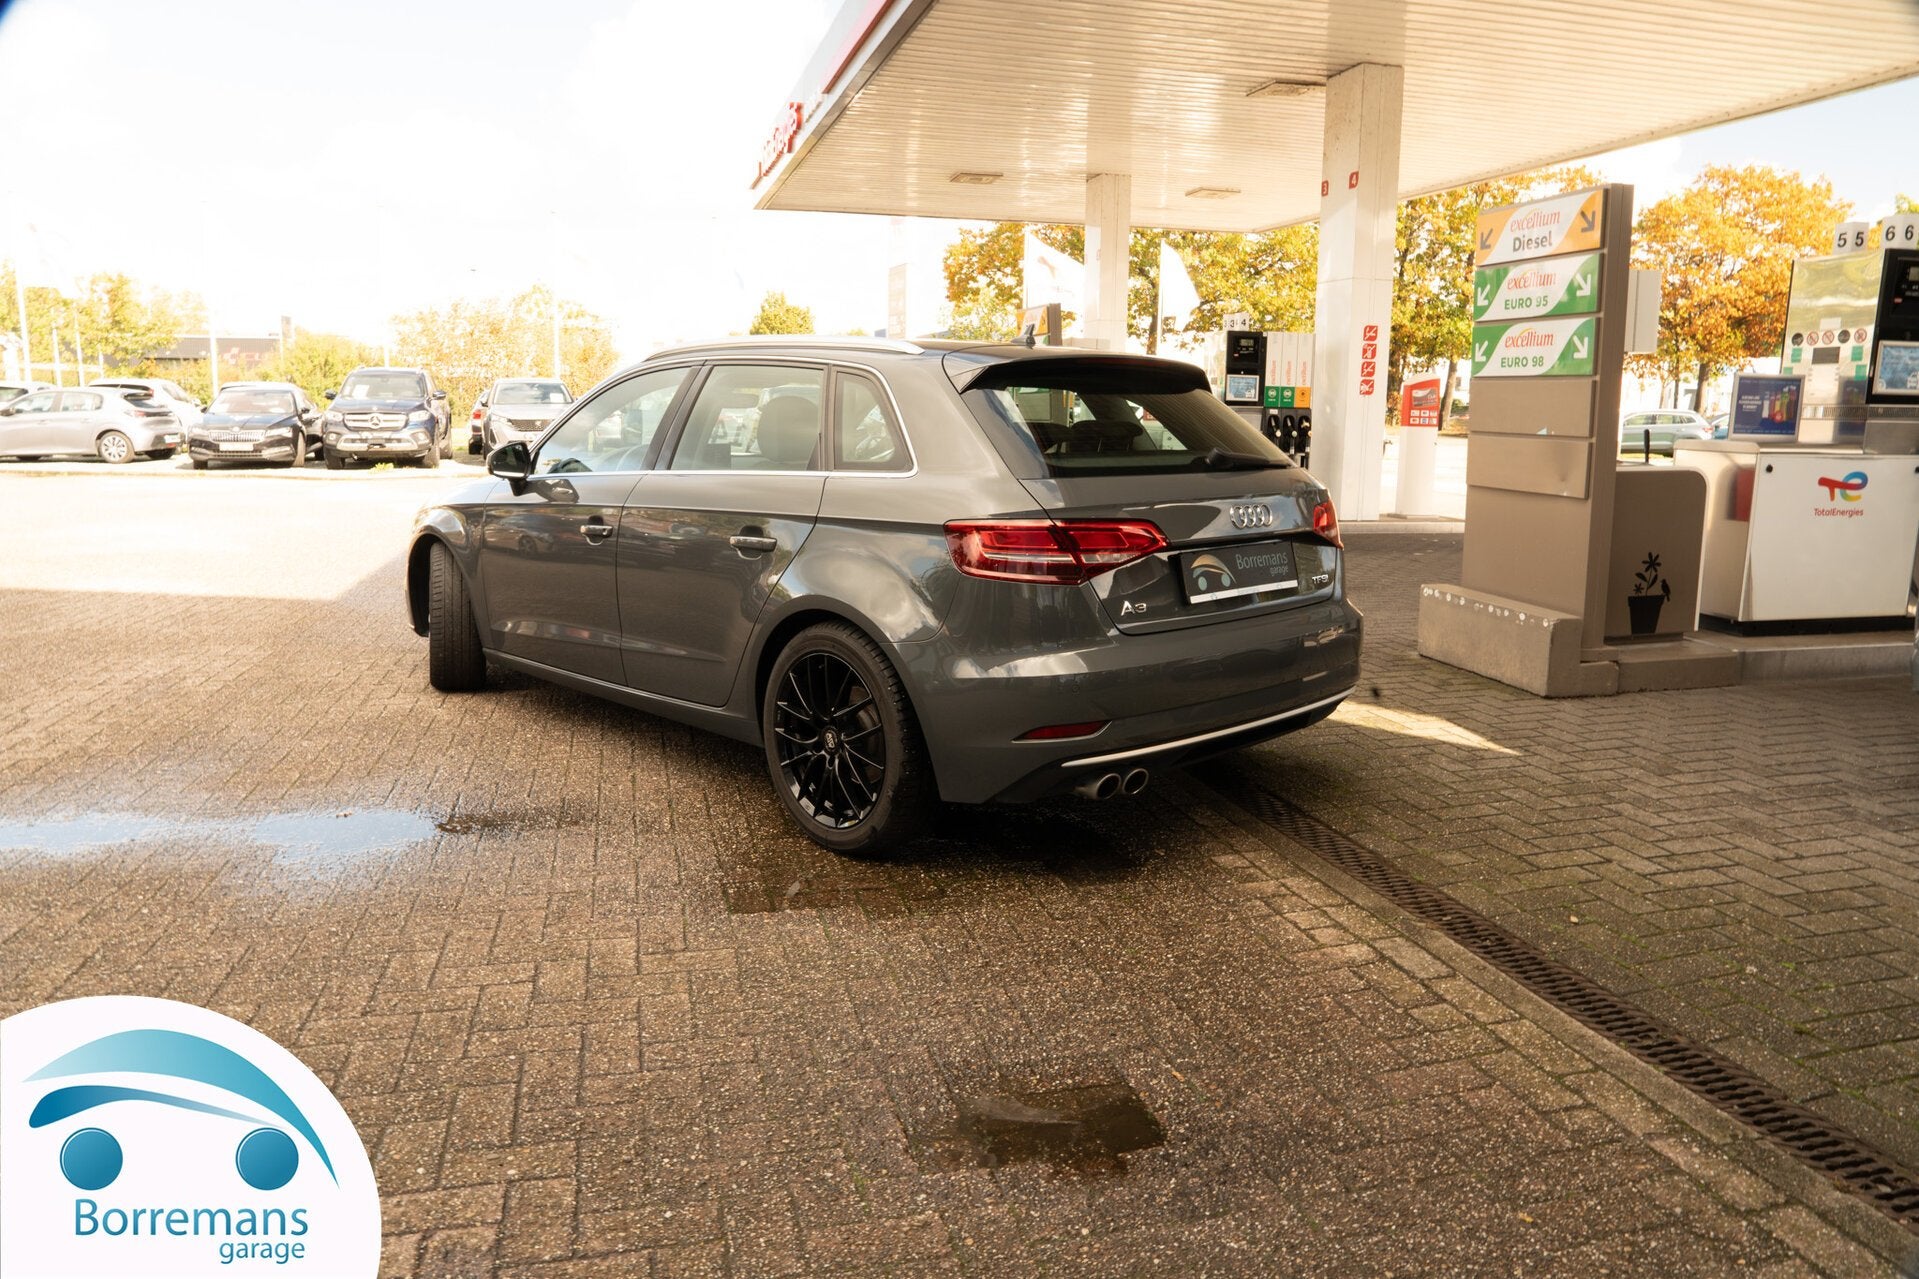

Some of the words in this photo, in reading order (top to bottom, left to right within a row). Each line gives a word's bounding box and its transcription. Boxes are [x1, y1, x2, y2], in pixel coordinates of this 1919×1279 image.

[1510, 210, 1560, 233] excellium
[1837, 232, 1847, 248] 5
[1855, 231, 1864, 247] 5
[1885, 225, 1896, 241] 6
[1904, 224, 1914, 241] 6
[1512, 230, 1552, 253] Diesel
[1507, 271, 1557, 290] excellium
[1504, 297, 1532, 310] EURO
[1535, 295, 1549, 307] 95
[1504, 330, 1554, 348] excellium
[1500, 356, 1528, 368] EURO
[1531, 355, 1544, 368] 98
[1814, 508, 1864, 518] TotalEnergies
[1235, 551, 1289, 570] Borremans
[1270, 565, 1289, 577] garage
[1120, 600, 1147, 616] A3
